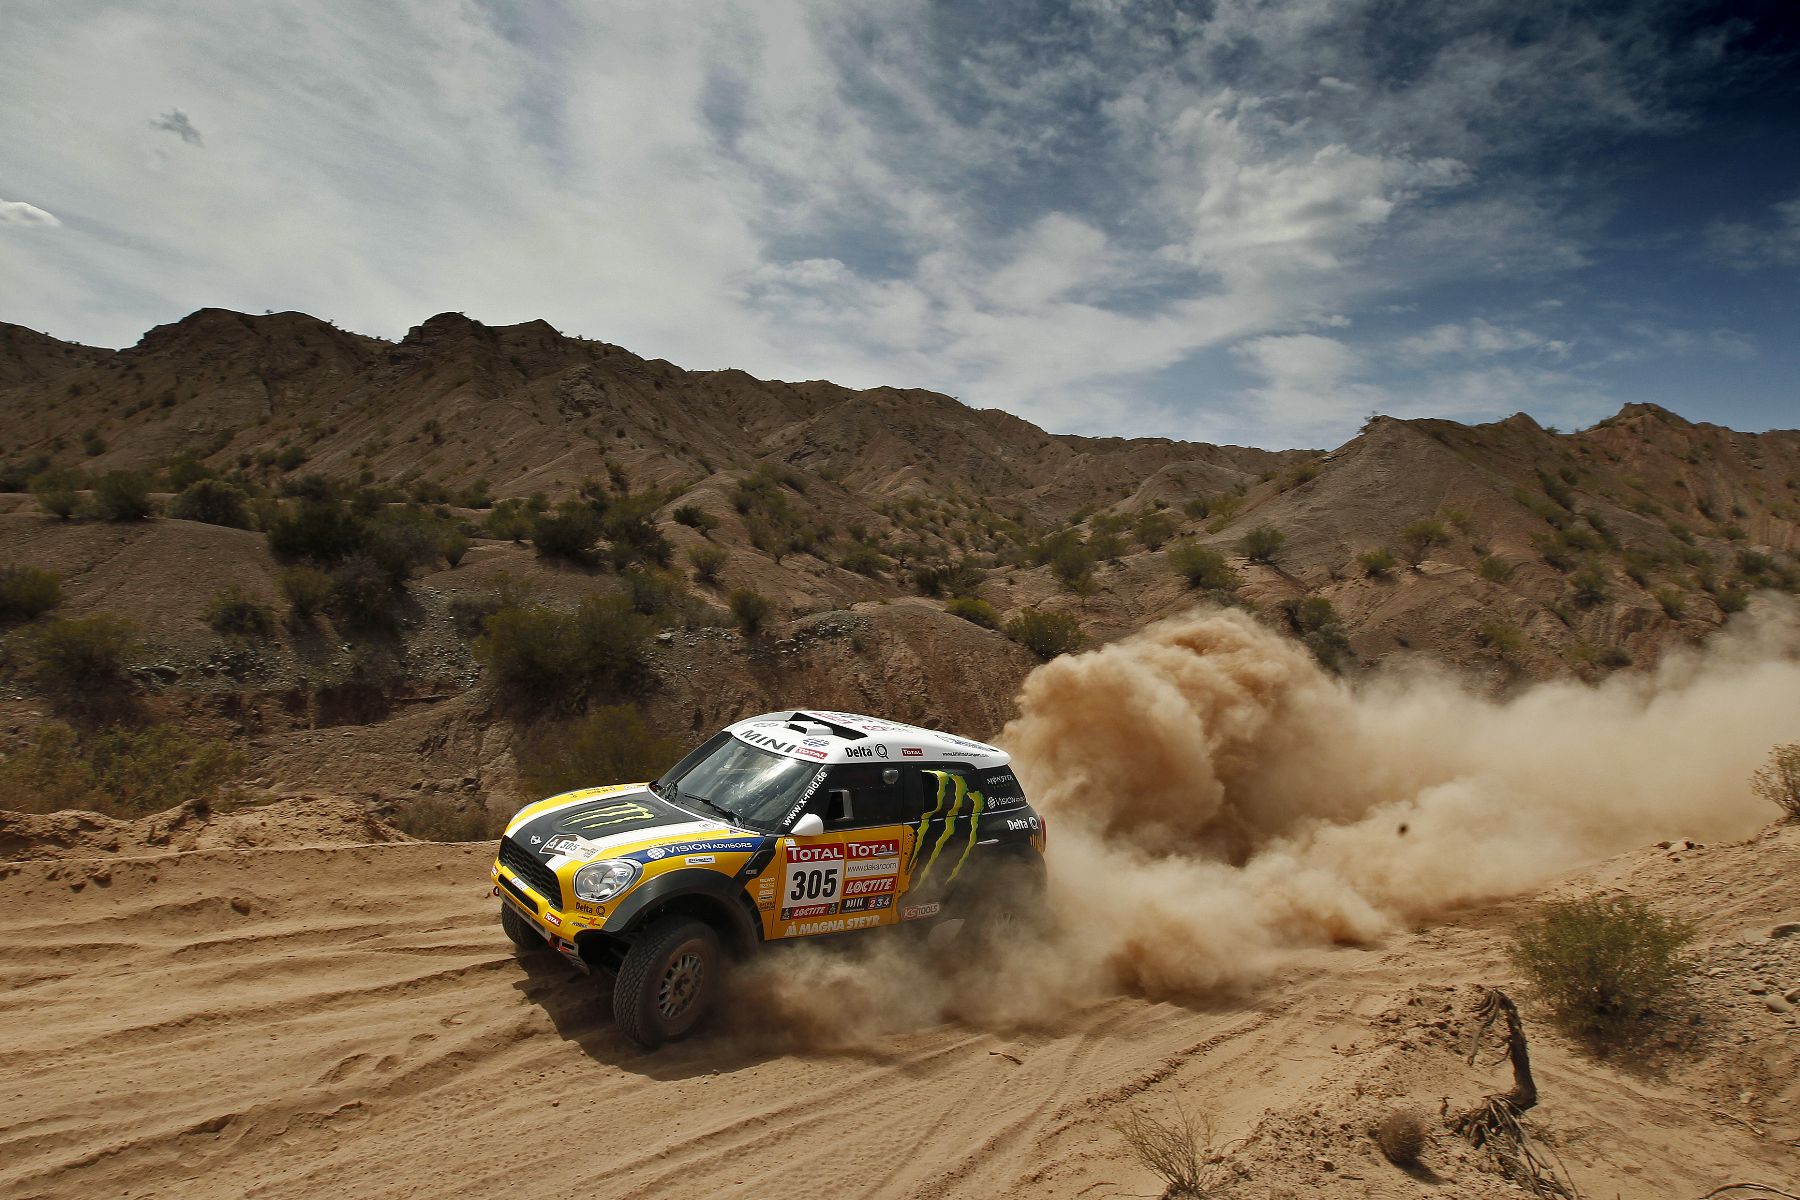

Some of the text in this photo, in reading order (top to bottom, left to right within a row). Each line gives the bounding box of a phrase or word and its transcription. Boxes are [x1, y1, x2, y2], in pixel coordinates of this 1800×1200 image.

[740, 730, 797, 753] MINI
[799, 748, 825, 759] TOTAL
[845, 746, 872, 758] Delta
[1007, 818, 1028, 830] Delta
[560, 841, 581, 851] 305
[664, 843, 712, 854] VISION
[788, 847, 843, 860] TOTAL
[847, 862, 897, 872] www.dakar.com
[791, 869, 837, 900] 305
[846, 878, 893, 894] LOCTITE
[576, 902, 593, 914] Delta
[794, 906, 825, 916] LOCTITE
[545, 913, 561, 926] TOTAL
[800, 915, 880, 934] MAGNA STEYR
